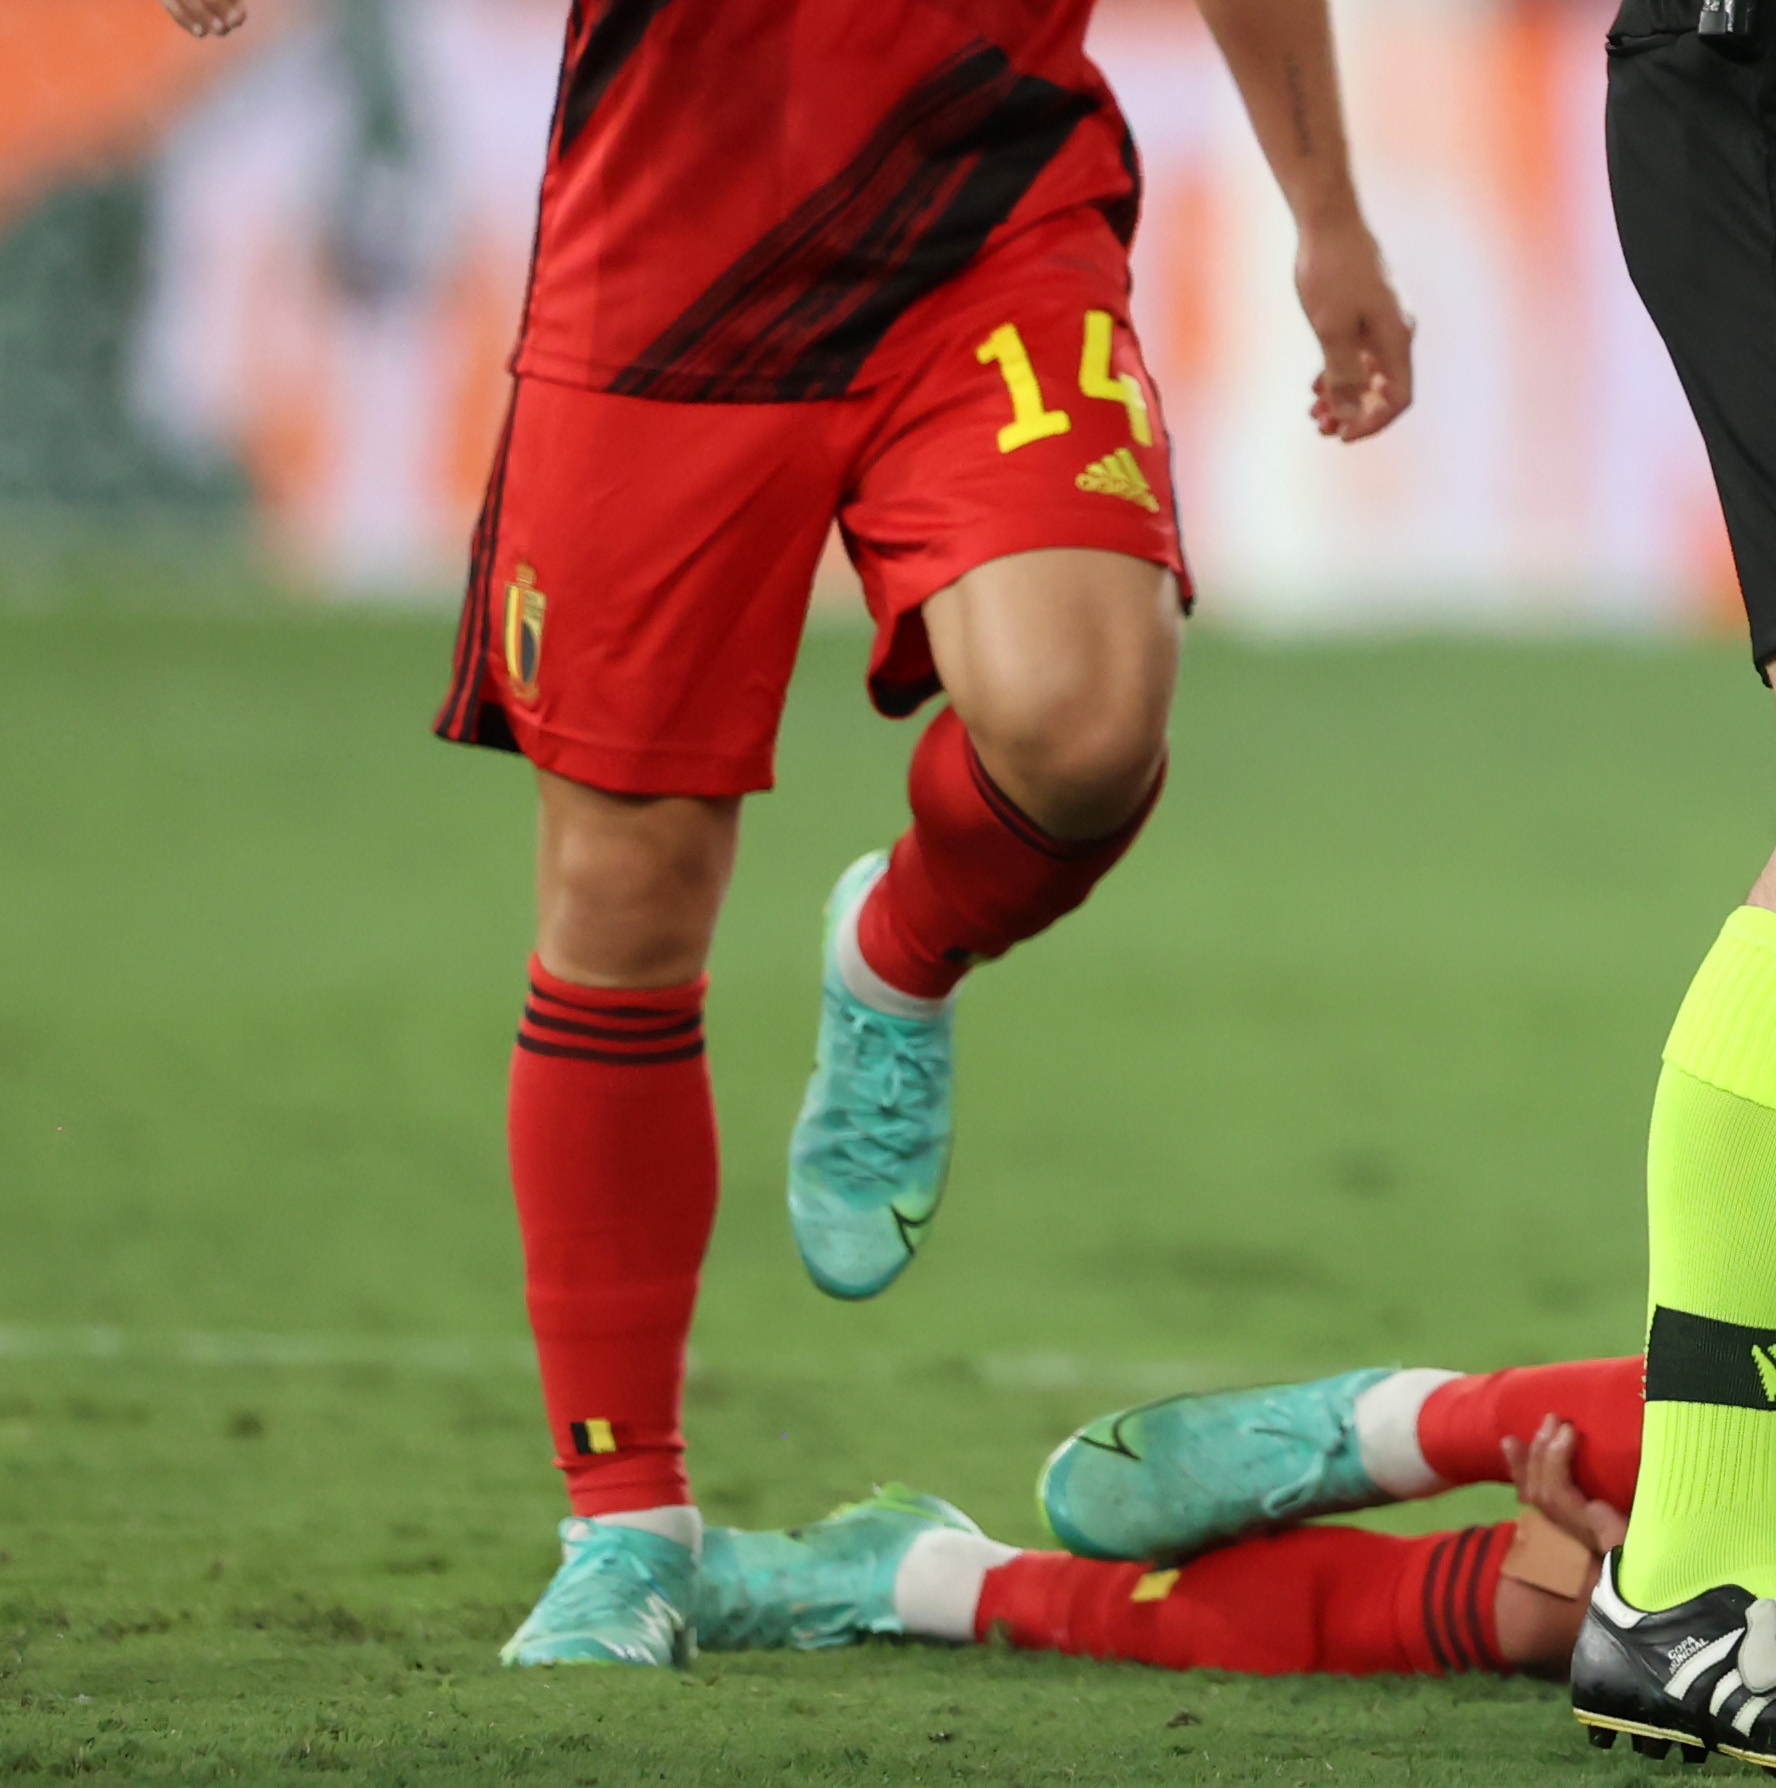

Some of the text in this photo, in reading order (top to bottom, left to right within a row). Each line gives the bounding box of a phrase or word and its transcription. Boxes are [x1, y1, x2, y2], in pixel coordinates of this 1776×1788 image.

[975, 309, 1153, 454] 14
[1668, 1635, 1699, 1660] COPA
[1669, 1637, 1710, 1675] MUNDIAL
